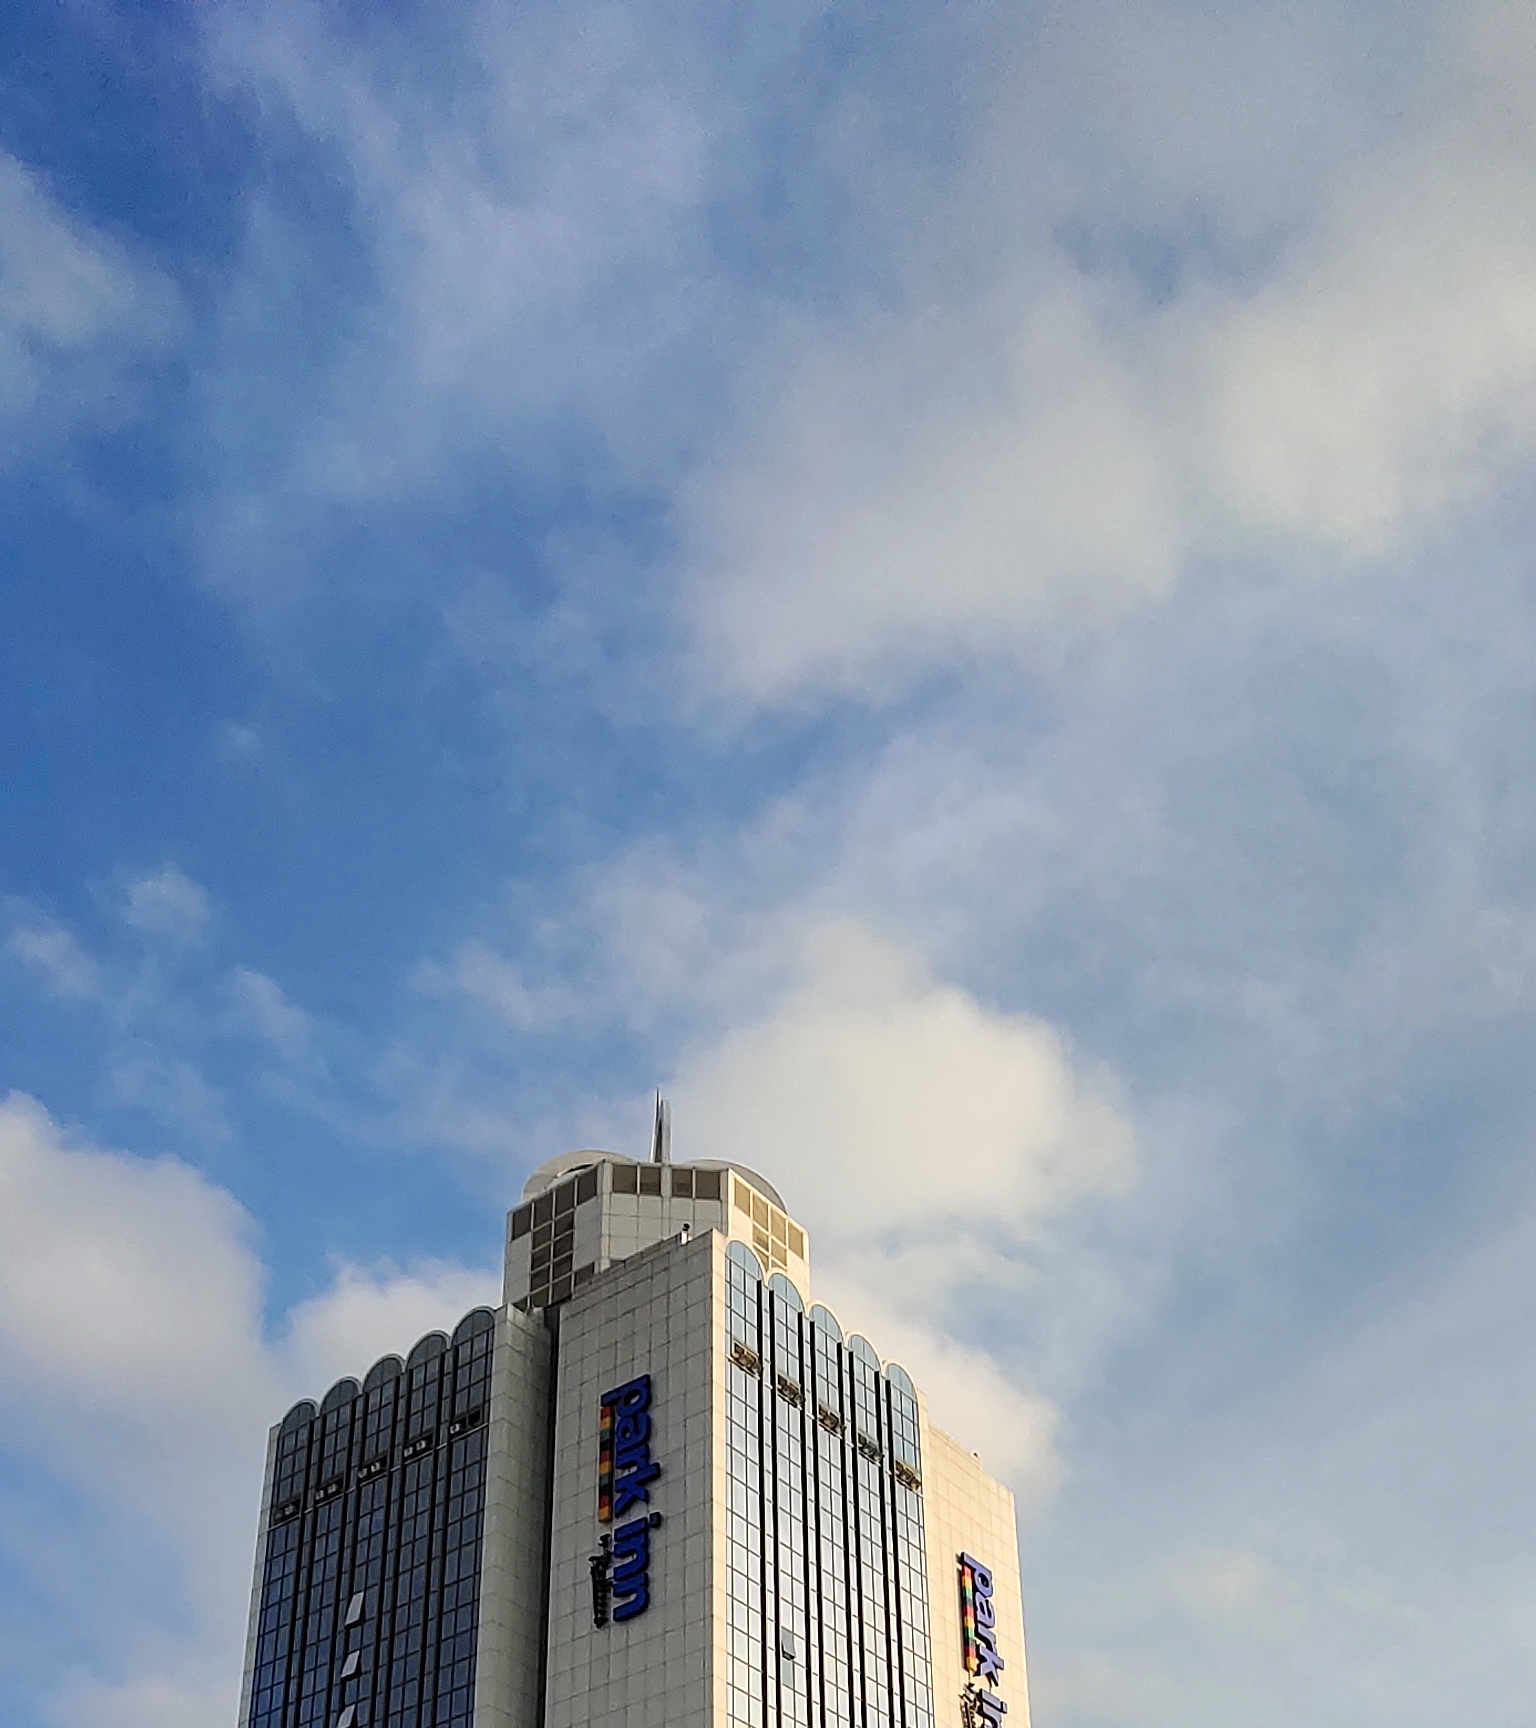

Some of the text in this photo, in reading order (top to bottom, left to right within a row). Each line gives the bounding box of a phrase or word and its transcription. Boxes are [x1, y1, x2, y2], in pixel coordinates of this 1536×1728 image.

[600, 1374, 661, 1518] park
[612, 1511, 662, 1622] inn
[957, 1552, 1005, 1687] park
